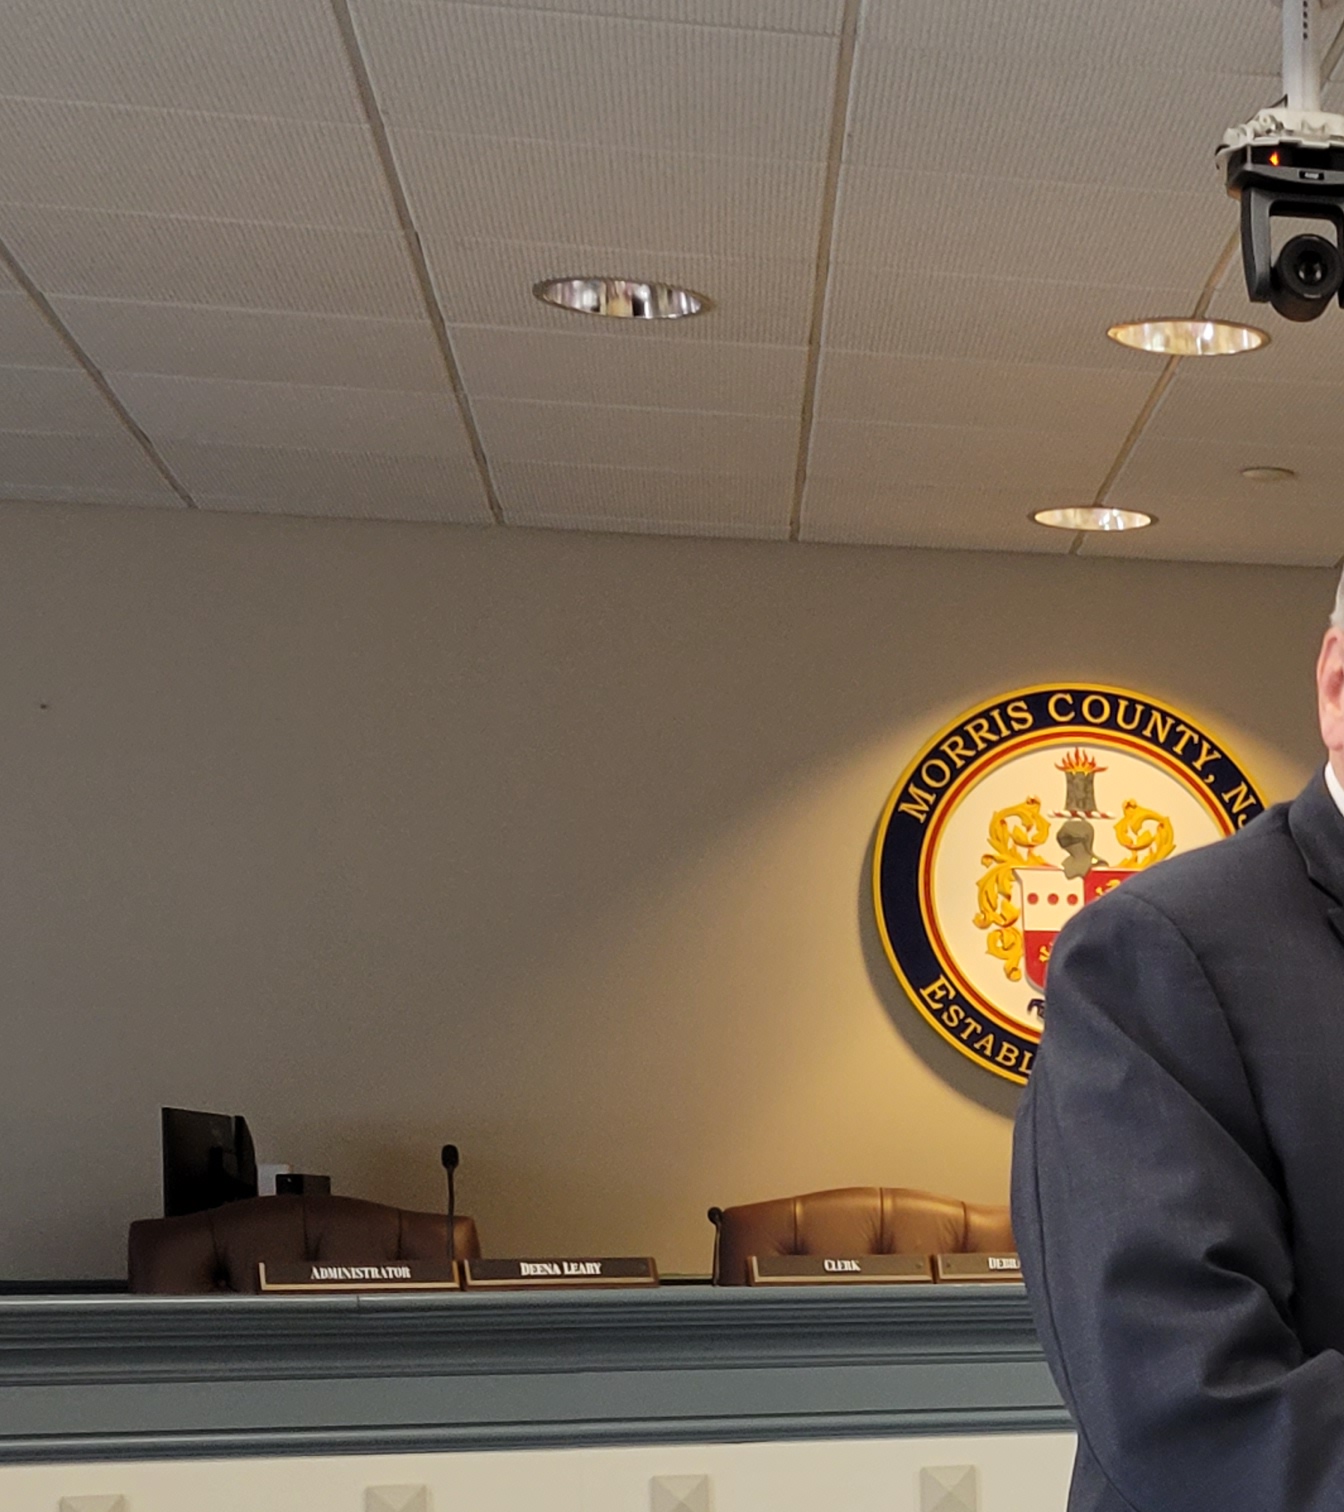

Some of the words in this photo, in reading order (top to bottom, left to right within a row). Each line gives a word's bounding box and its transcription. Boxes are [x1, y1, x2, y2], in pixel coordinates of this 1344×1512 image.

[897, 699, 1034, 824] MORRIS
[1047, 692, 1222, 784] COUNTY,
[519, 1262, 561, 1276] DEENA
[562, 1261, 602, 1275] LEARY
[823, 1258, 861, 1272] CLERK
[310, 1266, 412, 1280] ADMINISTRATOR
